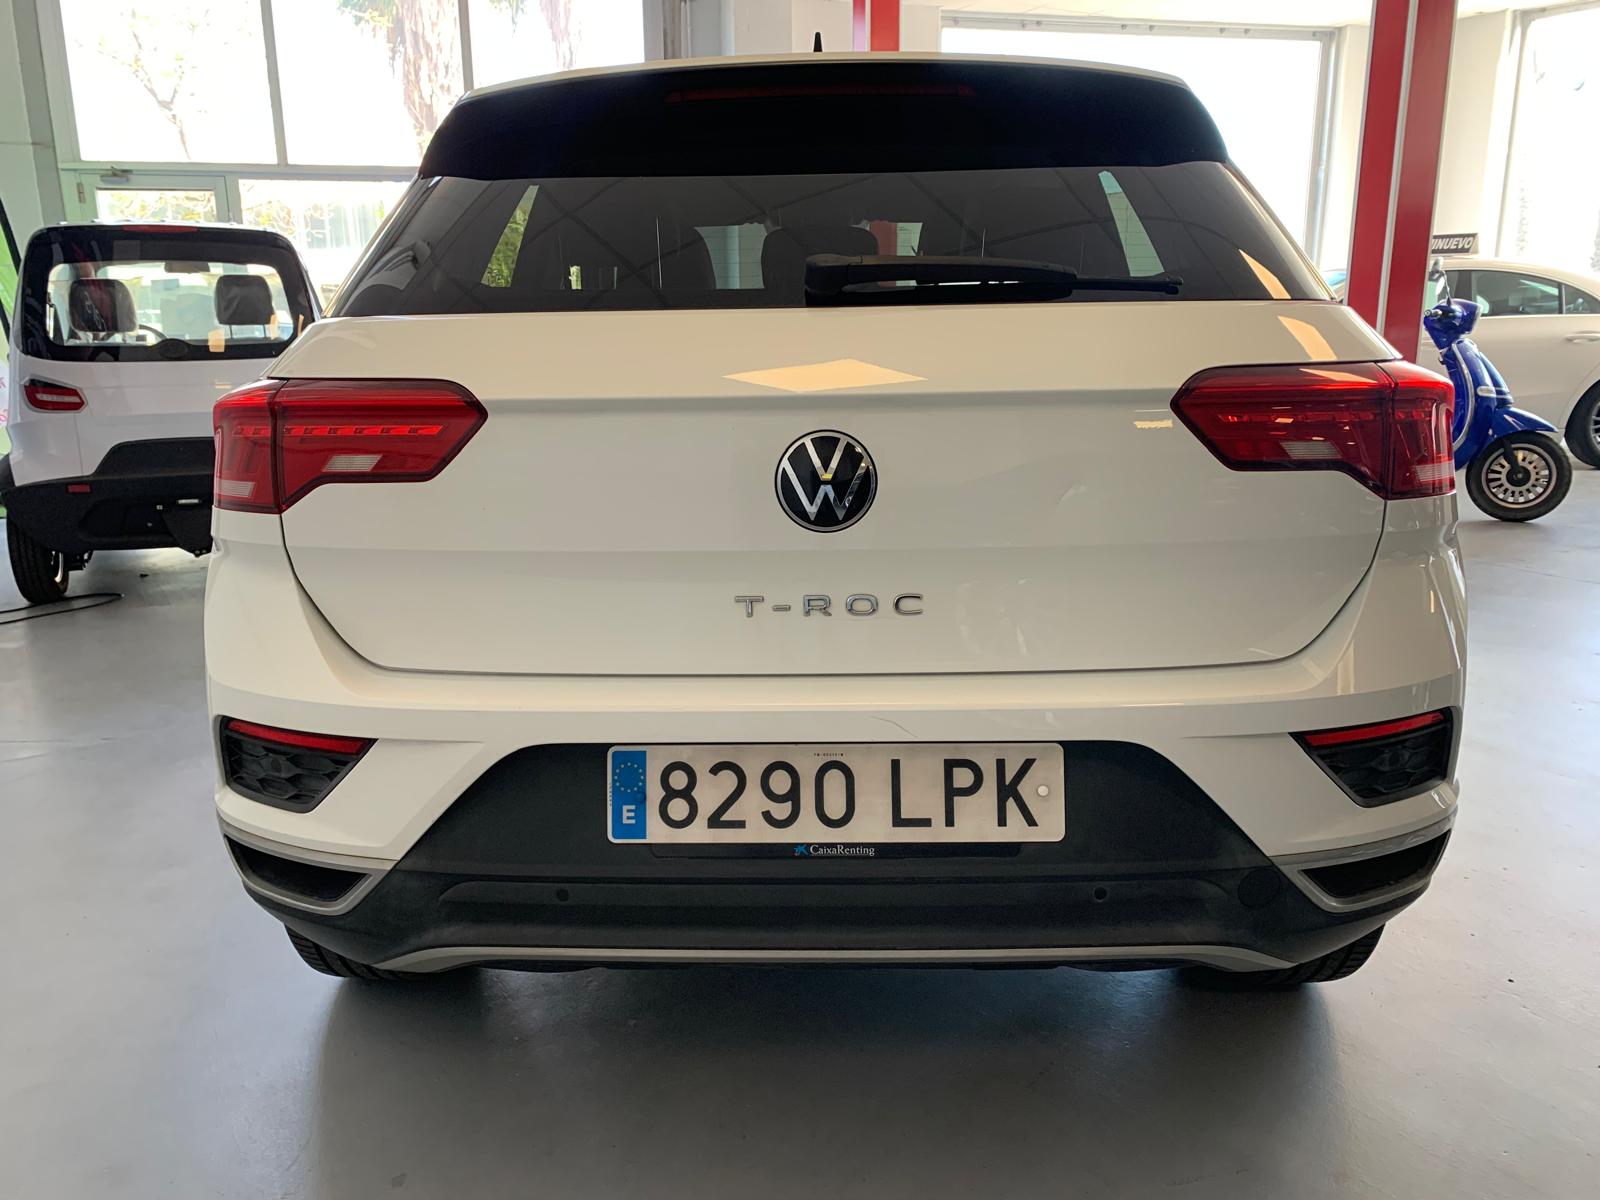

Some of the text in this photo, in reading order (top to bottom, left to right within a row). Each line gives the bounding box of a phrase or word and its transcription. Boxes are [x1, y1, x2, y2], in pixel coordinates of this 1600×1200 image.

[735, 593, 924, 618] T-ROC
[658, 758, 1039, 829] 8290 LPK
[622, 805, 636, 824] E
[810, 844, 875, 856] CaixaRenting
